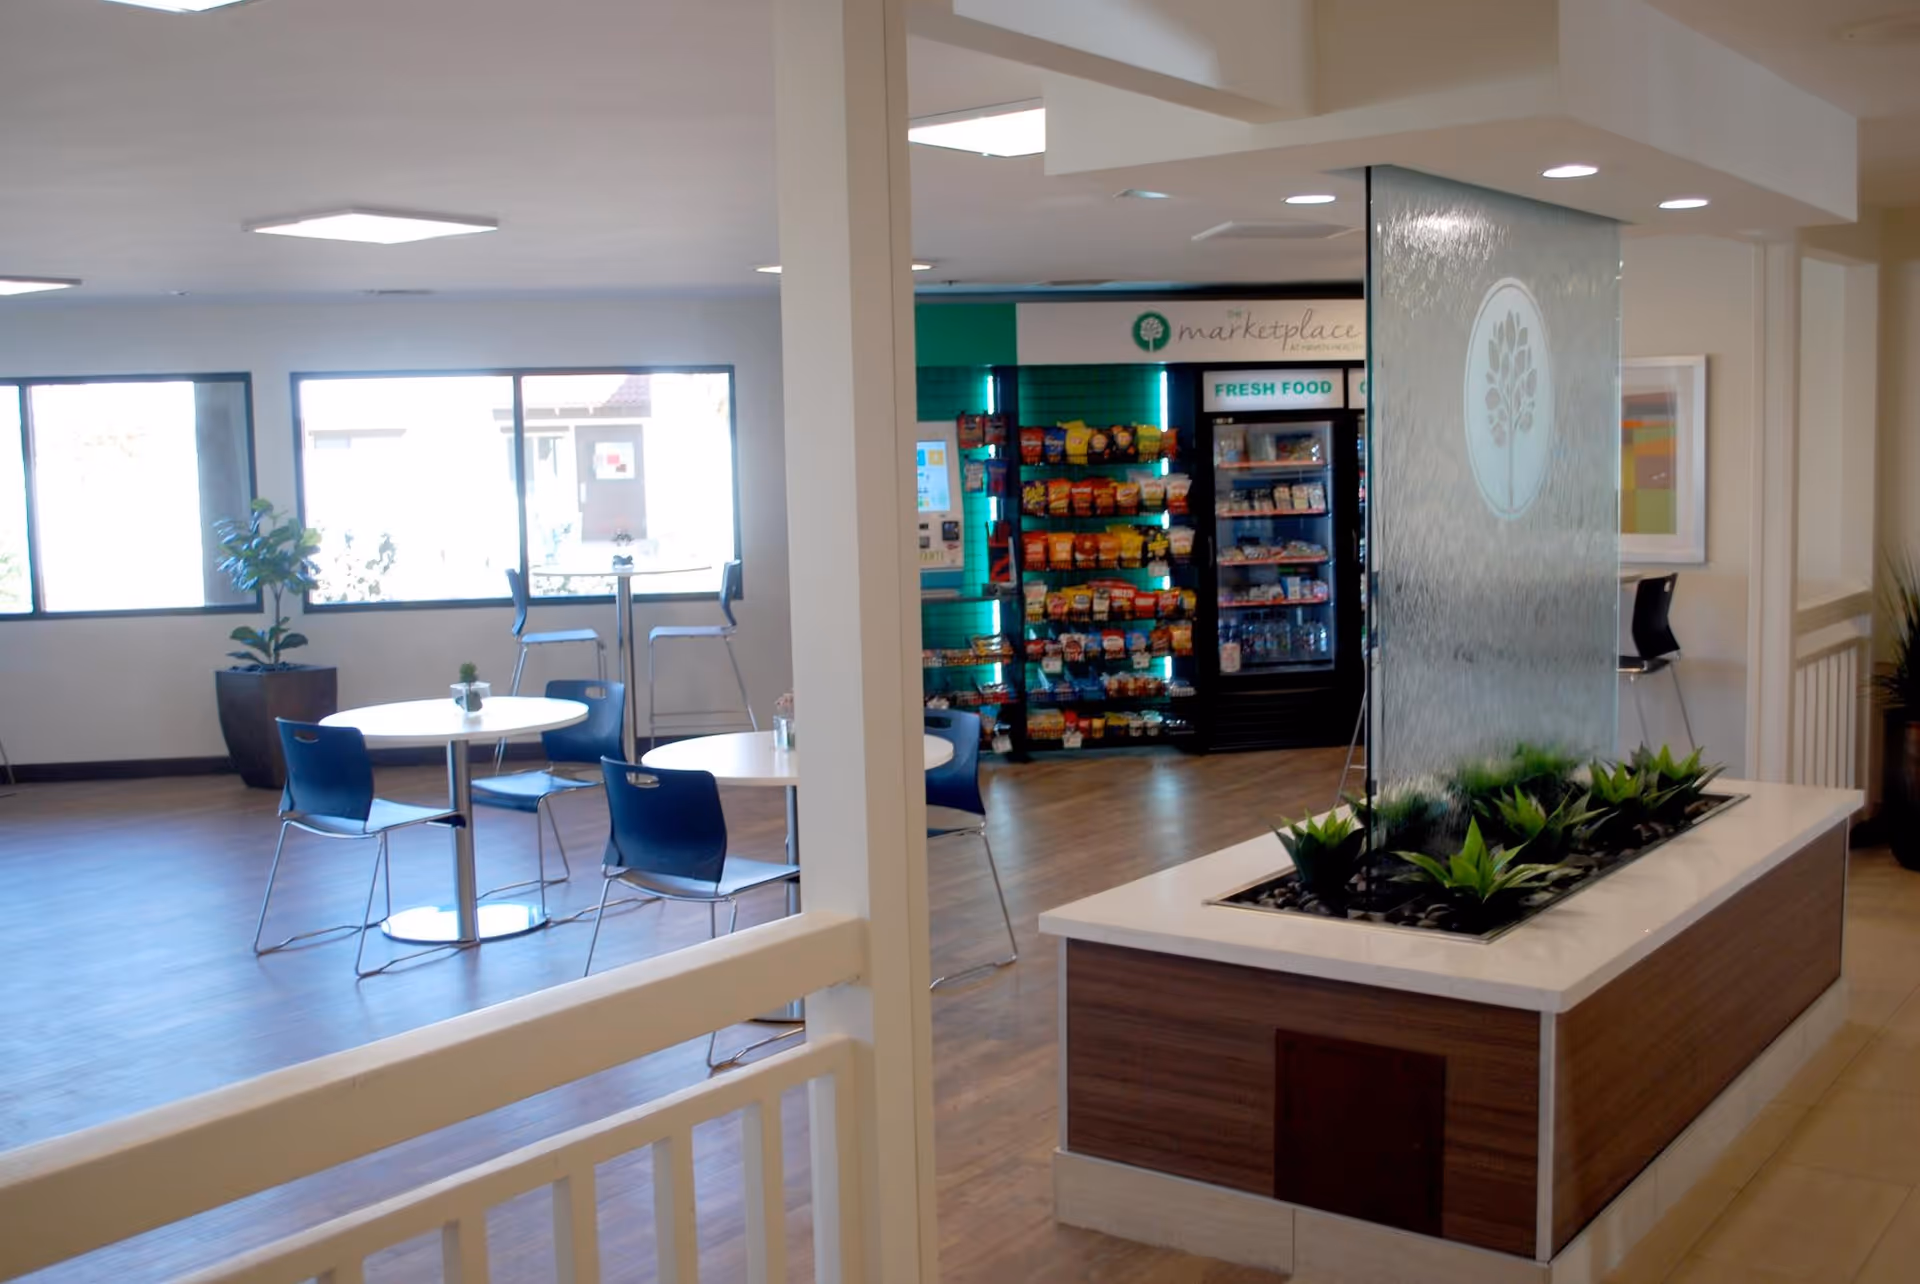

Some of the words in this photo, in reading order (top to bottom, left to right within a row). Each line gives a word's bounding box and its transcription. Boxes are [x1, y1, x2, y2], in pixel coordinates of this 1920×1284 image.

[1178, 308, 1361, 353] marketplace
[1214, 381, 1275, 397] FRESH
[1282, 380, 1333, 395] FOOD
